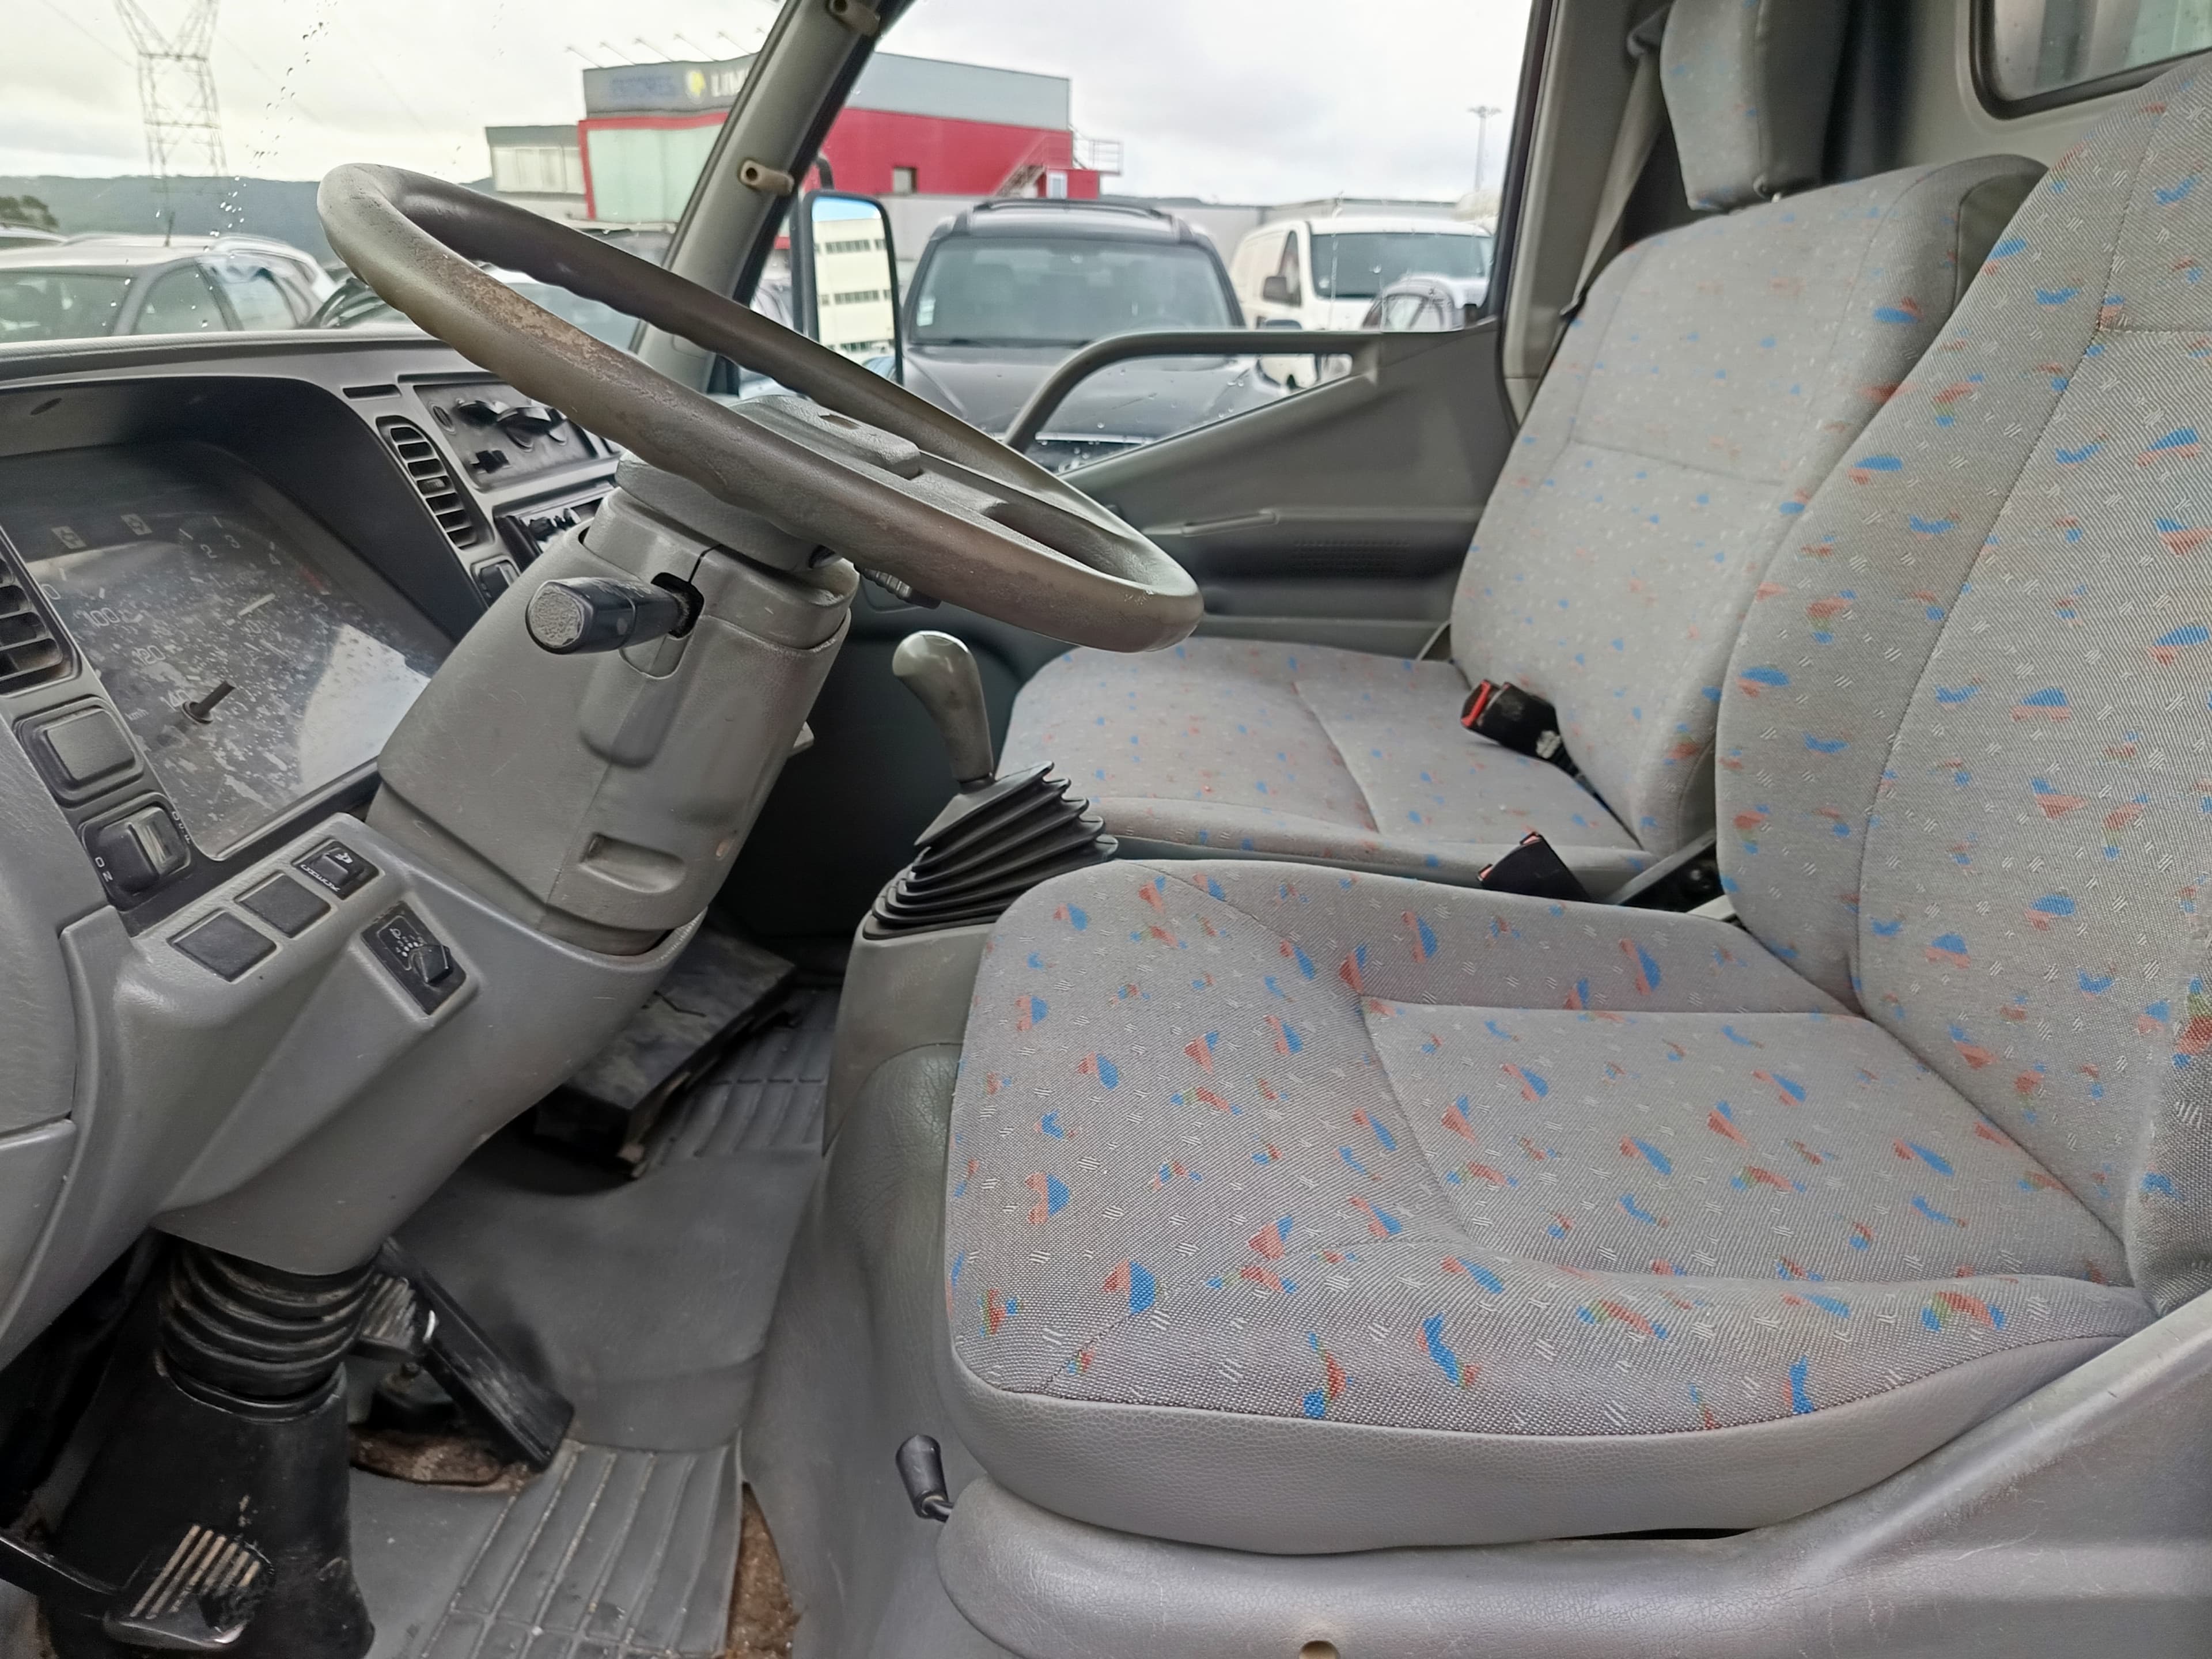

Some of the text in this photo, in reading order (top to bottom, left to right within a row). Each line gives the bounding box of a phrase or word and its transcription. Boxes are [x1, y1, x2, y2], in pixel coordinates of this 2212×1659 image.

[225, 535, 240, 548] 3
[201, 544, 217, 559] 2
[84, 608, 120, 627] 100
[132, 645, 166, 665] 120
[94, 857, 113, 882] ON
